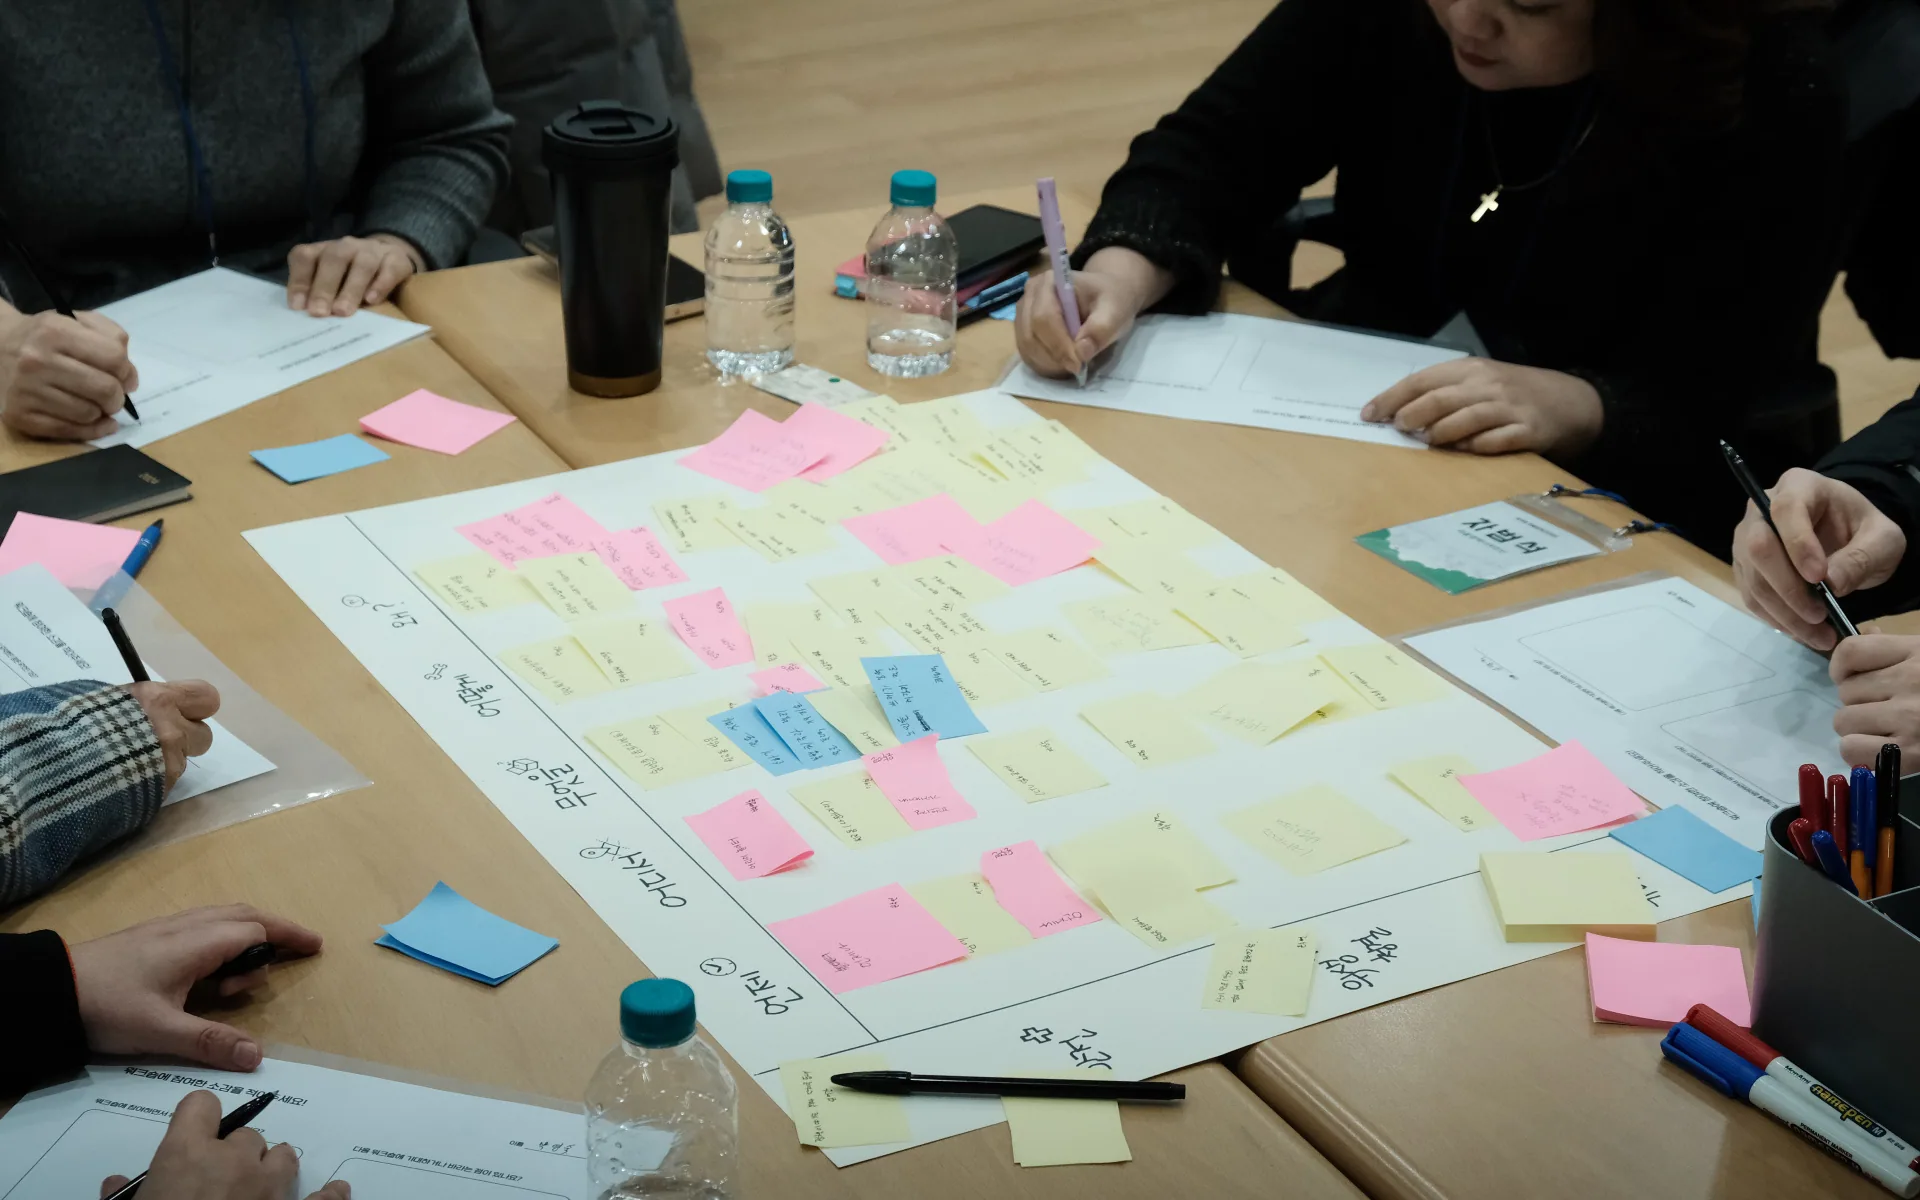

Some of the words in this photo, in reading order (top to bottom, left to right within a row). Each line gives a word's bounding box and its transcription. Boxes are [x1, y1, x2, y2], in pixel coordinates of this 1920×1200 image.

[372, 603, 418, 628] 왜?
[453, 673, 501, 718] 어떻게
[528, 763, 597, 810] 무엇을
[618, 851, 687, 908] 어디서
[1319, 954, 1378, 991] 위생
[740, 970, 804, 1015] 언제
[124, 1066, 171, 1082] 워크숍에
[170, 1074, 208, 1088] 참여한
[207, 1081, 244, 1095] 소감을
[1800, 1122, 1832, 1145] PERMANENT
[1830, 1142, 1853, 1159] MARKER
[371, 1149, 405, 1160] 워크숍에
[407, 1155, 447, 1168] 기대하거나
[448, 1163, 474, 1173] 바라는
[492, 1171, 524, 1182] 있나요?
